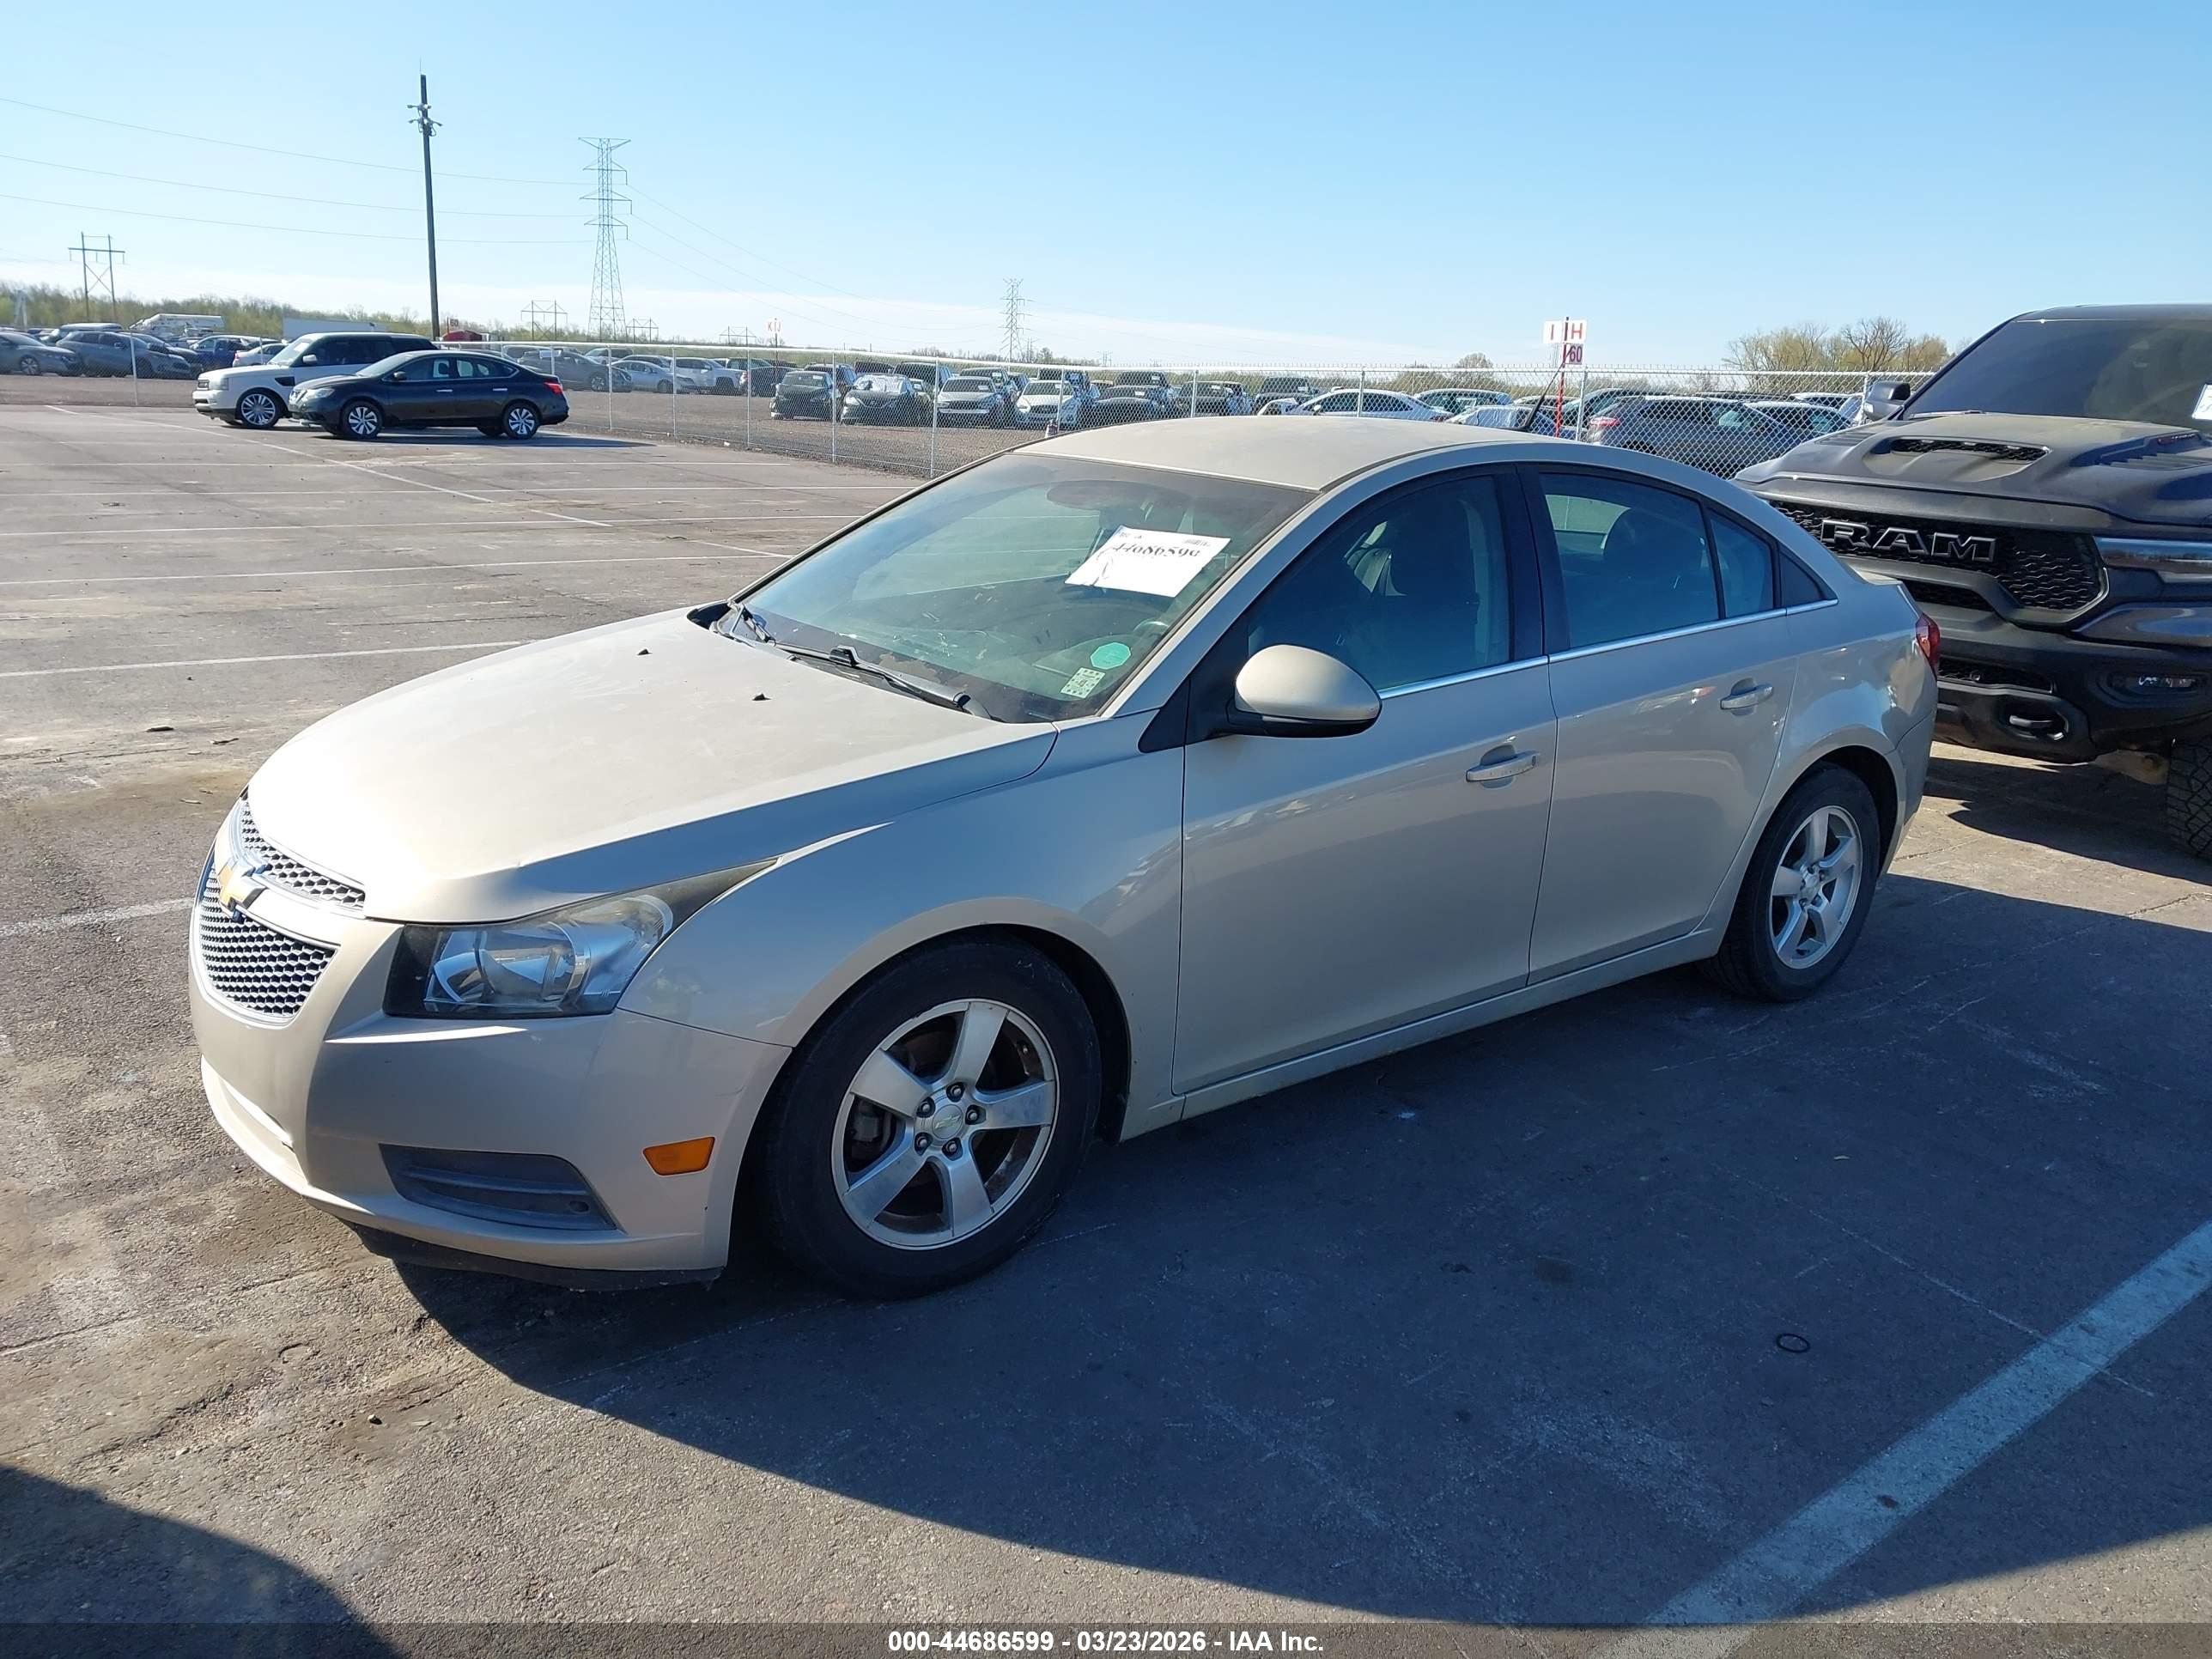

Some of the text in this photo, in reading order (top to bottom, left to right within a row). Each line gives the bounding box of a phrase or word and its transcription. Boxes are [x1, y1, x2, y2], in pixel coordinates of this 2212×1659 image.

[1570, 322, 1583, 340] H
[1569, 345, 1583, 362] 60
[1820, 519, 1996, 562] RAM
